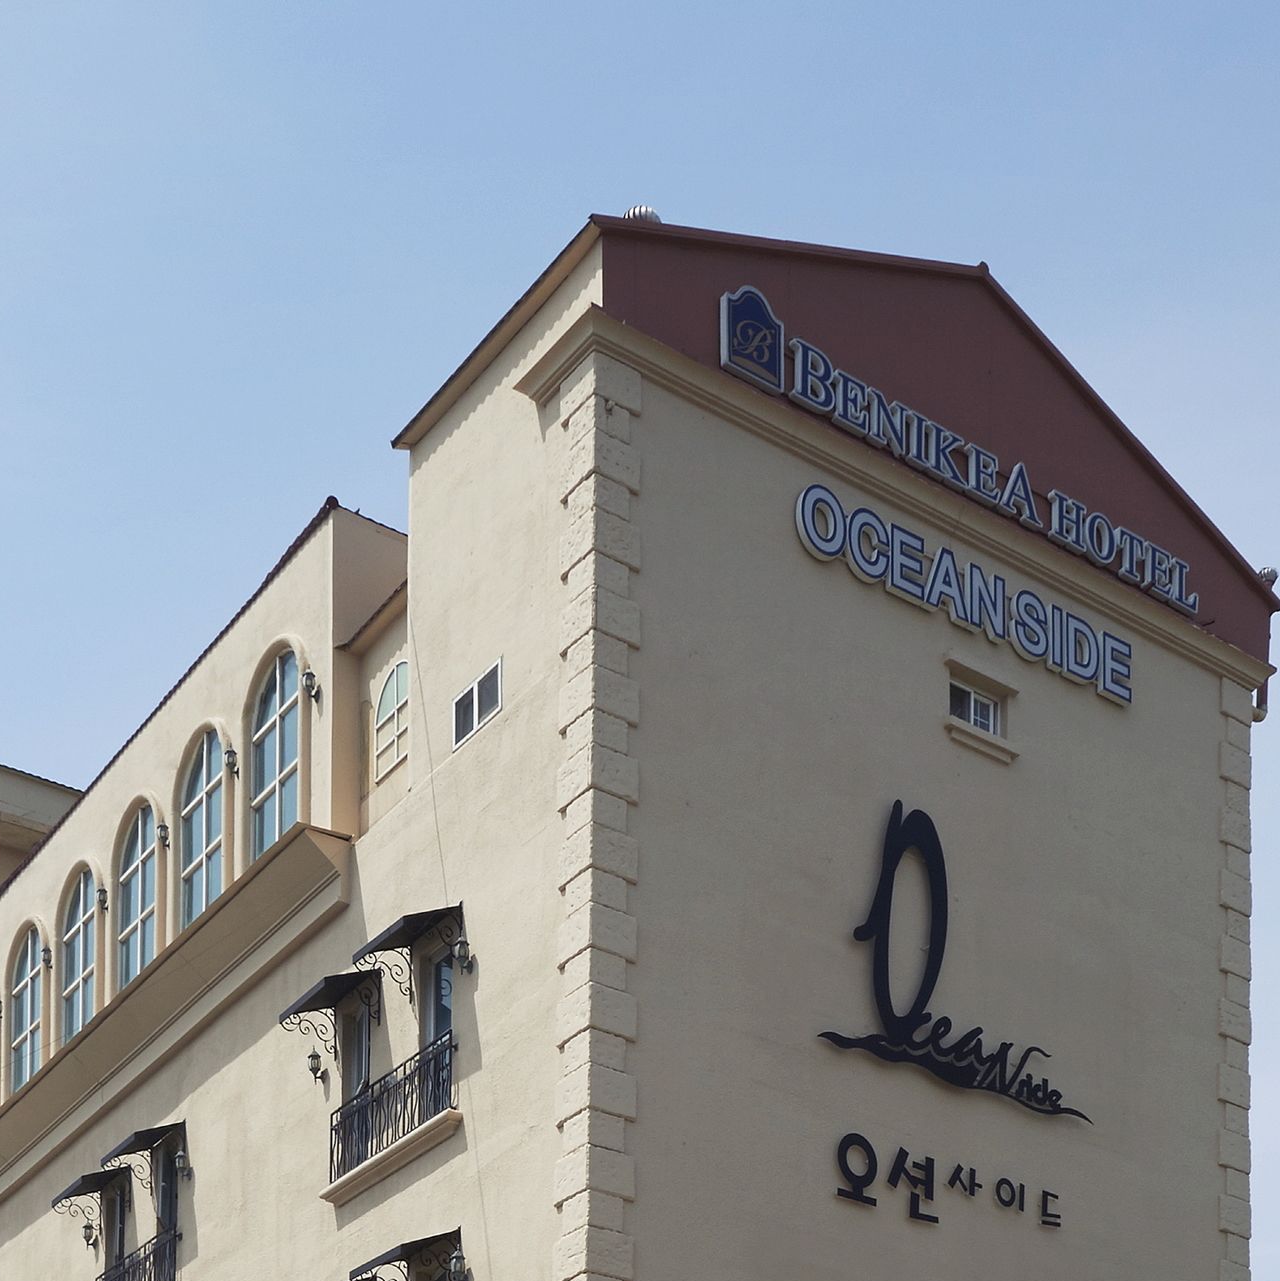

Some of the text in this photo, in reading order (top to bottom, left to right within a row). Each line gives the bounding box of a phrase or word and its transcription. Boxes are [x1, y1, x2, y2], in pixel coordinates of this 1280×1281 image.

[789, 337, 1198, 615] BENIKEA HOTEL
[796, 482, 1132, 707] OCEANSIDE
[836, 1133, 1062, 1227] 오션사이드
